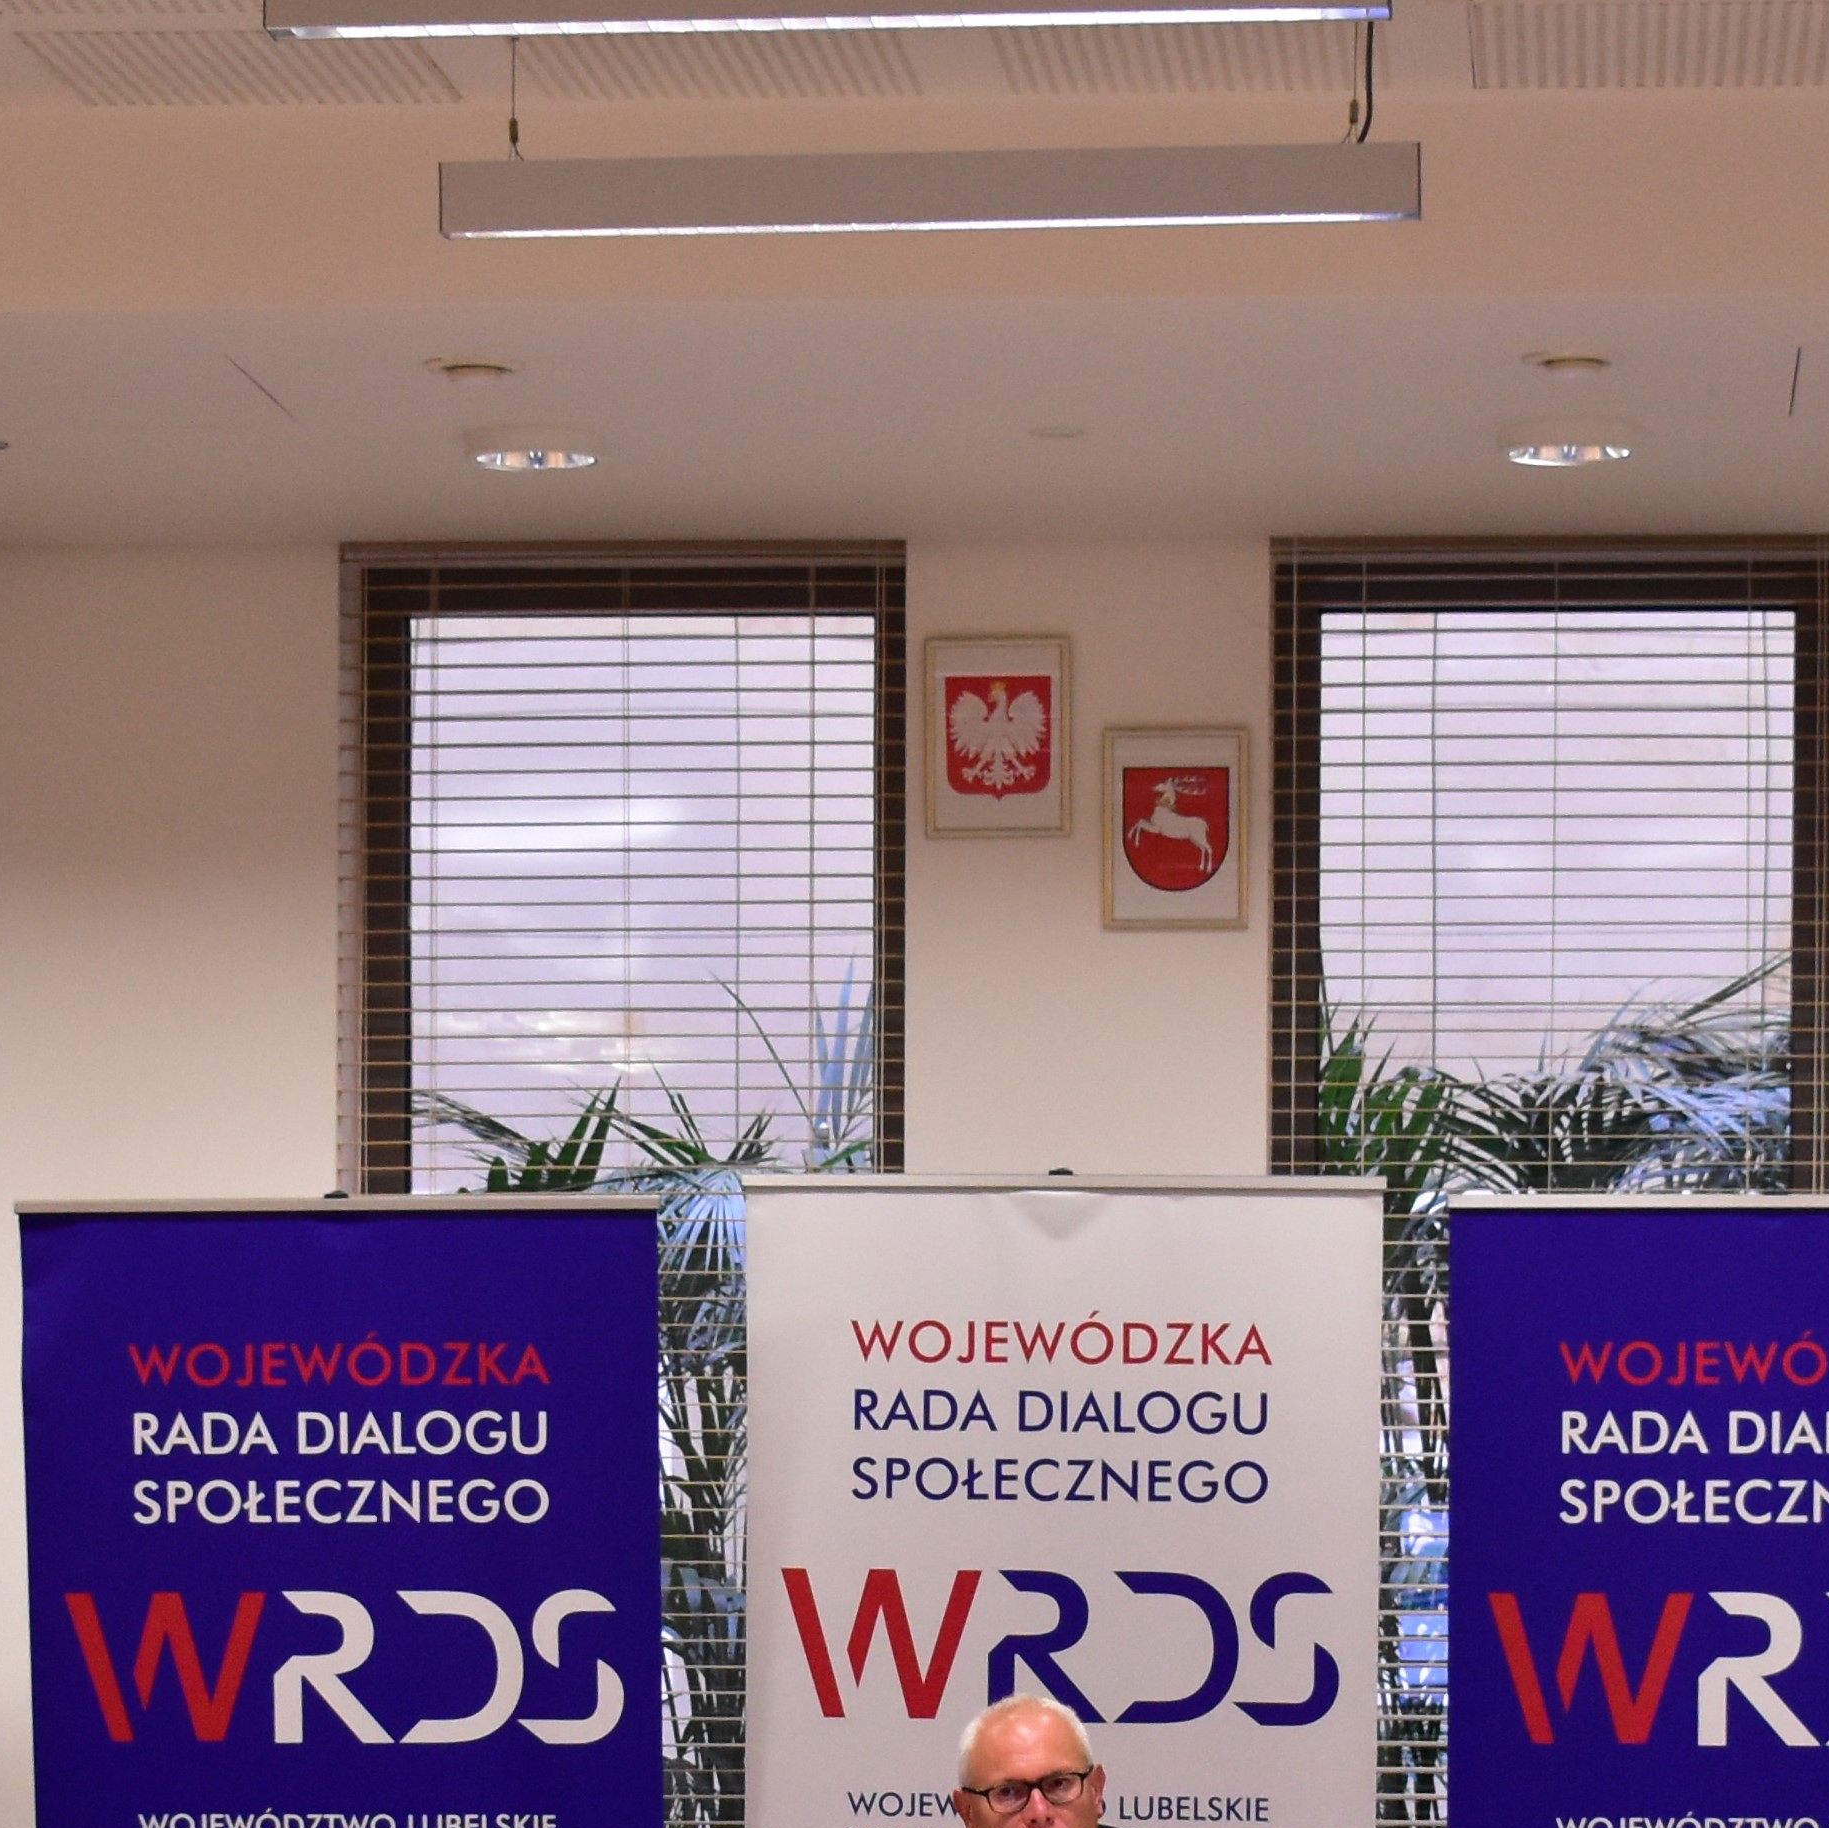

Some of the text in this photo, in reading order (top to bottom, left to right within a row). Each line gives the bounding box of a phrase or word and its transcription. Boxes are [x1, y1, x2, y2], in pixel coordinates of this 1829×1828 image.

[128, 1332, 551, 1387] WOJEWÓDZKA
[850, 1310, 1273, 1366] WOJEWÓDZKA
[132, 1410, 548, 1456] RADA DIALOGU
[853, 1388, 1269, 1436] RADA DIALOGU
[1560, 1410, 1710, 1455] RADA
[132, 1478, 550, 1525] SPOŁECZNEGO
[850, 1456, 1270, 1505] SPOŁECZNEGO
[63, 1588, 626, 1746] WRDS
[780, 1567, 1341, 1727] WRDS
[1119, 1796, 1270, 1822] LUBELSKIE
